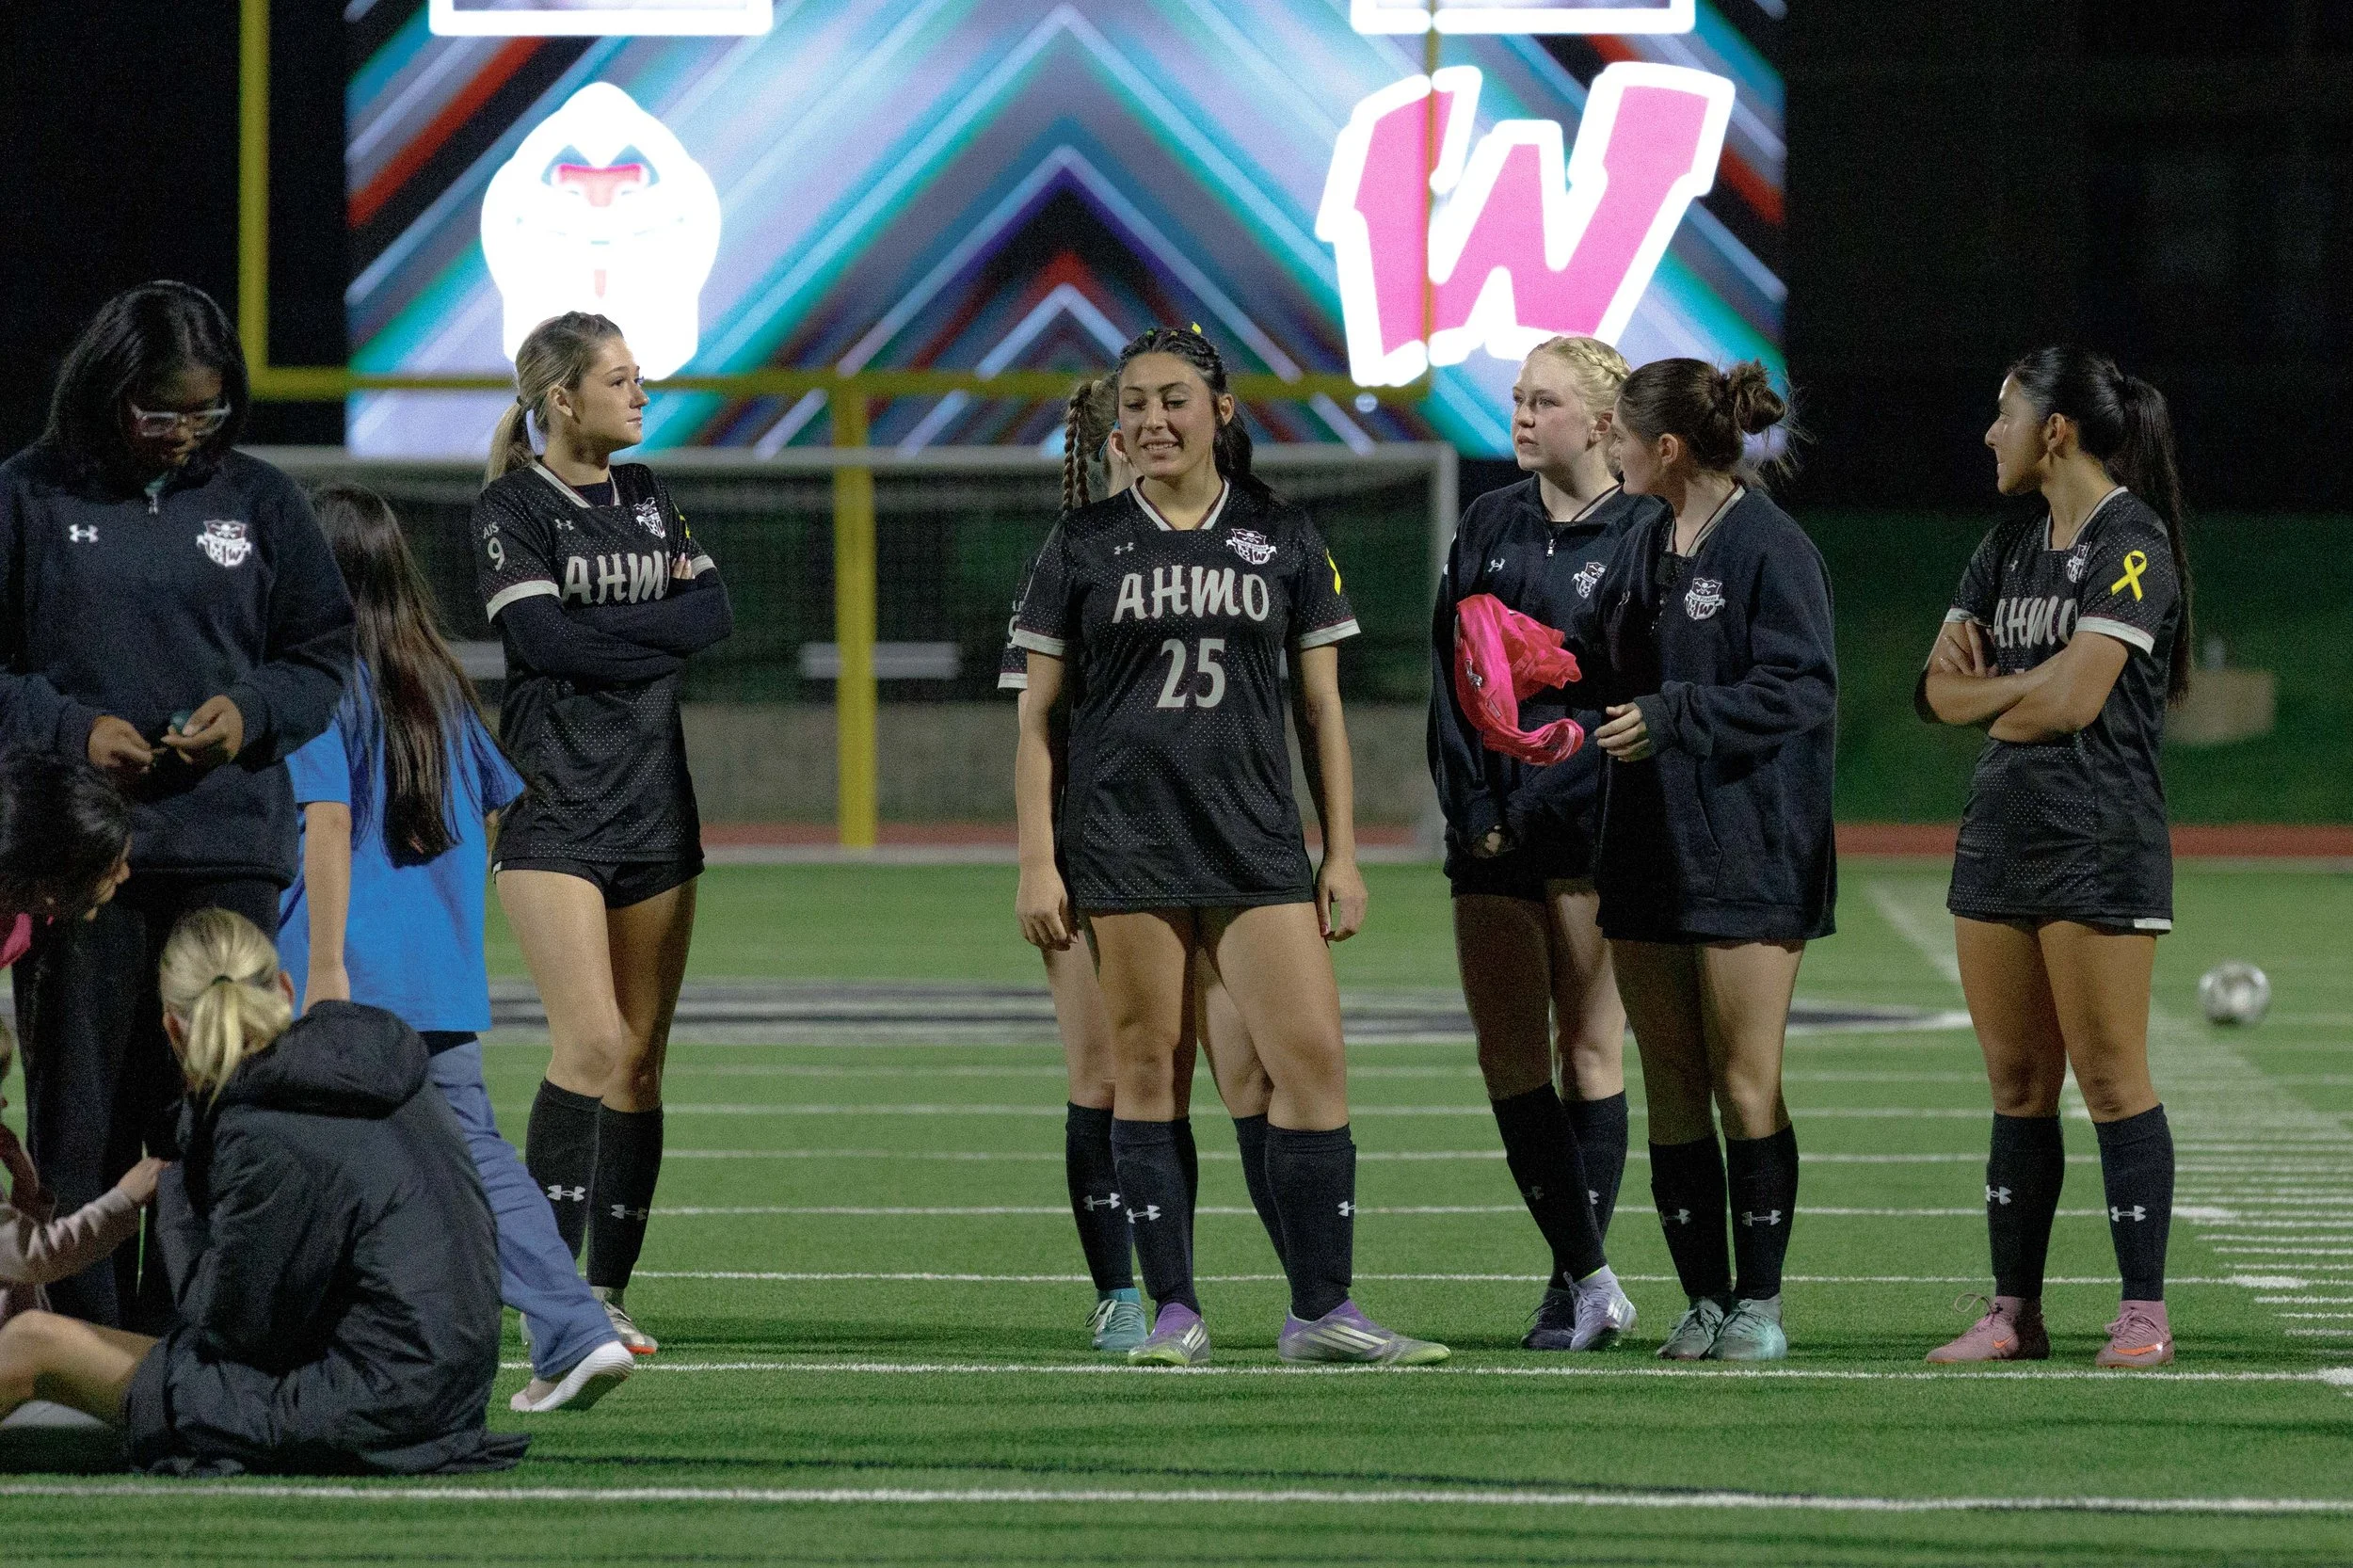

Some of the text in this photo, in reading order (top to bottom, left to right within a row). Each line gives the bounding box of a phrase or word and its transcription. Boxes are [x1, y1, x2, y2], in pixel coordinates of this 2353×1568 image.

[1316, 61, 1736, 386] W
[487, 536, 505, 571] 9
[561, 550, 671, 604] AHM
[1253, 551, 1267, 562] W
[1112, 565, 1270, 624] AHMO
[1699, 603, 1714, 616] W
[1156, 638, 1226, 708] 25
